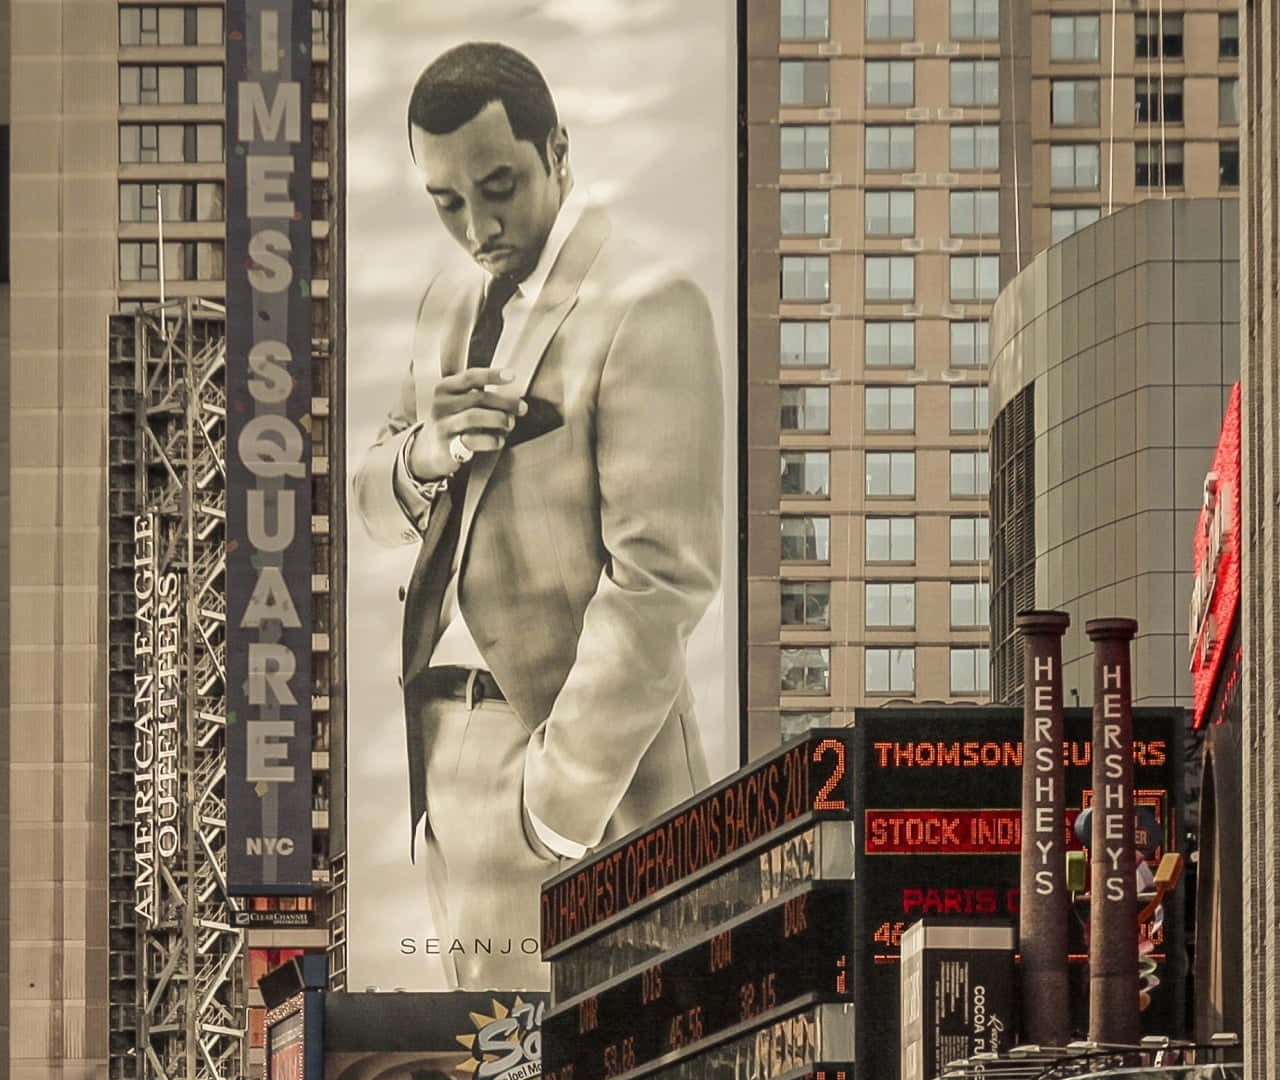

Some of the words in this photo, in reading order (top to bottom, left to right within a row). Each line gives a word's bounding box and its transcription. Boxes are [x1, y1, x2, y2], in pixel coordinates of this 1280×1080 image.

[134, 513, 154, 656] EAGLE
[236, 340, 307, 785] SQUARE
[158, 572, 179, 858] OUTFITTERS
[873, 741, 1024, 768] THOMSON
[134, 673, 154, 922] AMERICAN
[871, 816, 961, 847] STOCK
[245, 837, 295, 856] NYC
[559, 851, 623, 942] HARVEST
[625, 797, 721, 907] OPERATIONS
[724, 764, 780, 856] BACKS
[902, 889, 997, 913] PARIS
[973, 985, 986, 1033] COCOA
